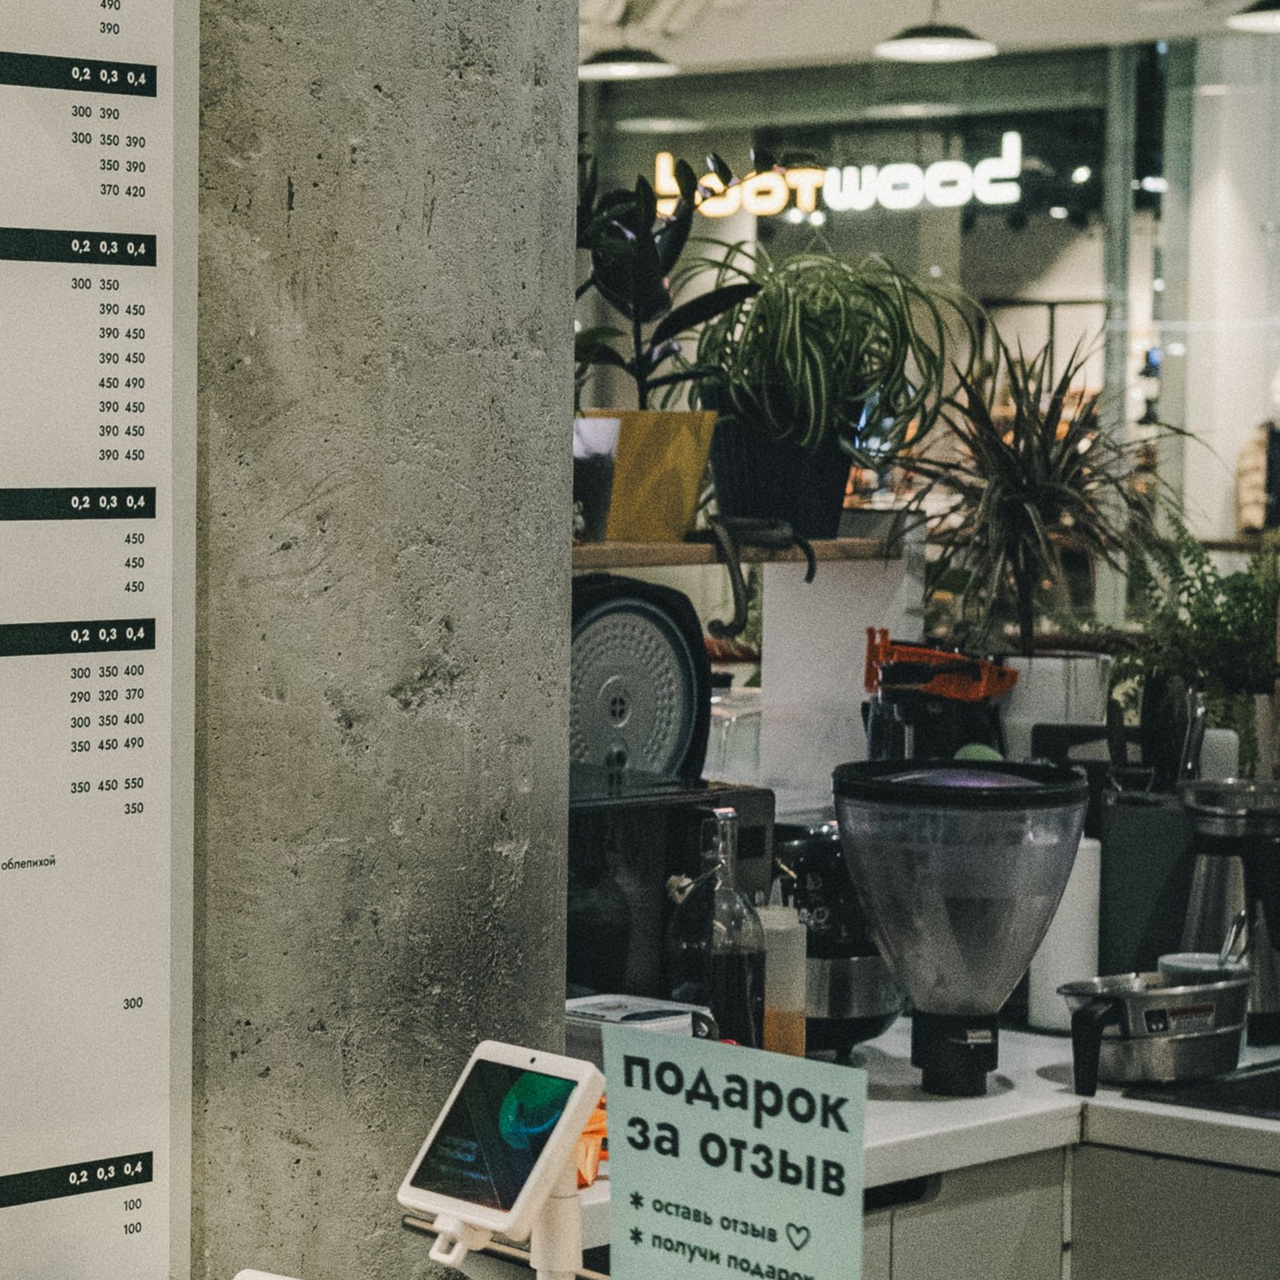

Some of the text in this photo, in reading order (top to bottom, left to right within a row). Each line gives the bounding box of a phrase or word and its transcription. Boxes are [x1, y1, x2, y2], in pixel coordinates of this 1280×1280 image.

[71, 66, 91, 82] 0,2
[99, 69, 119, 84] 0,3
[126, 71, 147, 86] 0,4
[71, 104, 93, 119] 300
[99, 106, 121, 121] 390
[71, 131, 93, 145] 300
[99, 133, 120, 147] 350
[125, 135, 147, 149] 390
[70, 495, 91, 510] 0,2
[98, 495, 118, 510] 0,3
[125, 495, 146, 509] 0,4
[124, 532, 146, 545] 450
[124, 556, 145, 569] 450
[124, 580, 145, 593] 450
[623, 1054, 849, 1132] подарок
[626, 1116, 847, 1197] за отзыв
[68, 1170, 89, 1185] 0,2
[96, 1165, 116, 1181] 0,3
[123, 1161, 143, 1176] 0,4
[651, 1198, 779, 1244] оставь отзыв
[651, 1230, 721, 1266] получи
